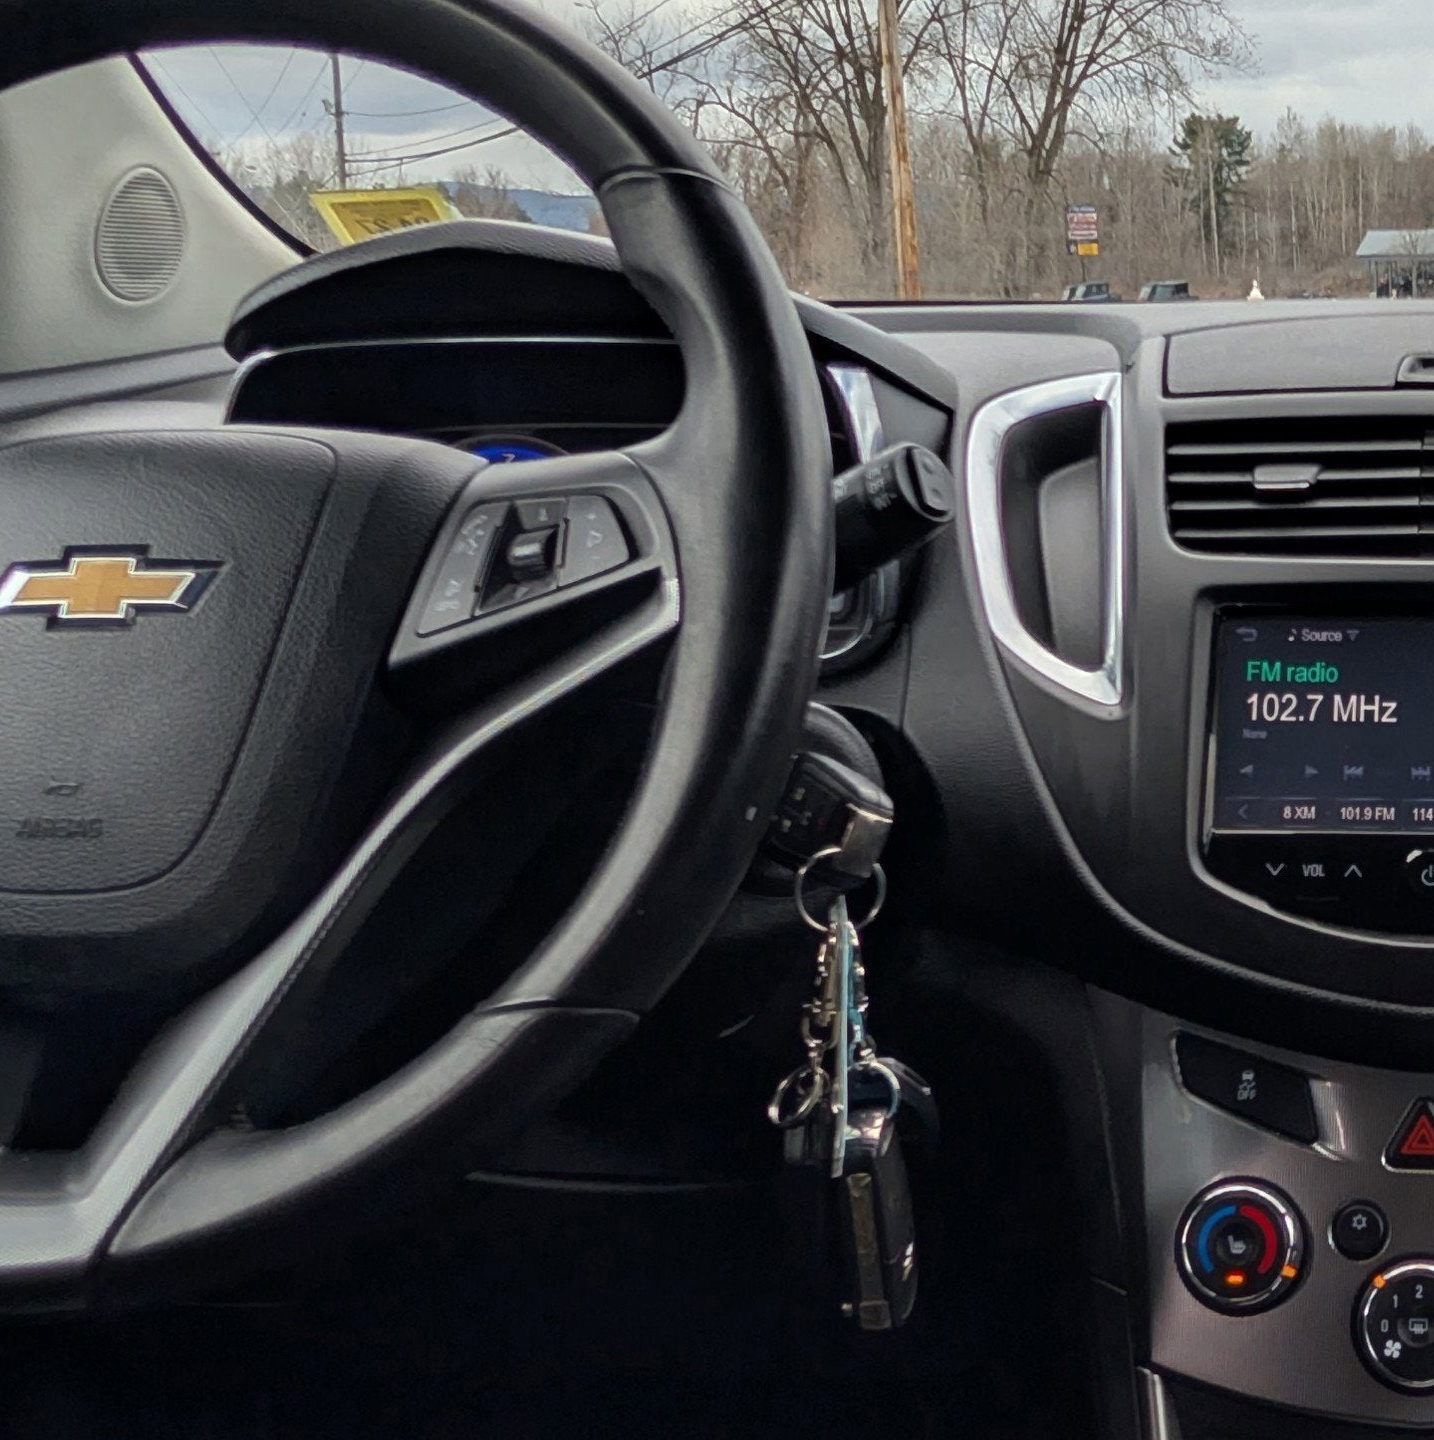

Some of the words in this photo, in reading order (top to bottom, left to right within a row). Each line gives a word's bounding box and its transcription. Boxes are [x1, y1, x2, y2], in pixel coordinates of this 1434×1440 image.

[1301, 628, 1343, 643] Source
[1246, 660, 1282, 683] FM
[1286, 661, 1340, 684] radio
[1246, 692, 1325, 723] 102.7
[1332, 693, 1399, 724] MHz
[1283, 806, 1292, 820] 8
[1294, 806, 1316, 820] XM
[1340, 806, 1373, 821] 101.9
[1375, 807, 1396, 822] FM
[1413, 807, 1434, 822] 114
[1302, 863, 1326, 878] VOL
[1415, 1284, 1424, 1299] 2
[1392, 1294, 1399, 1309] 1
[1380, 1319, 1389, 1333] 0
